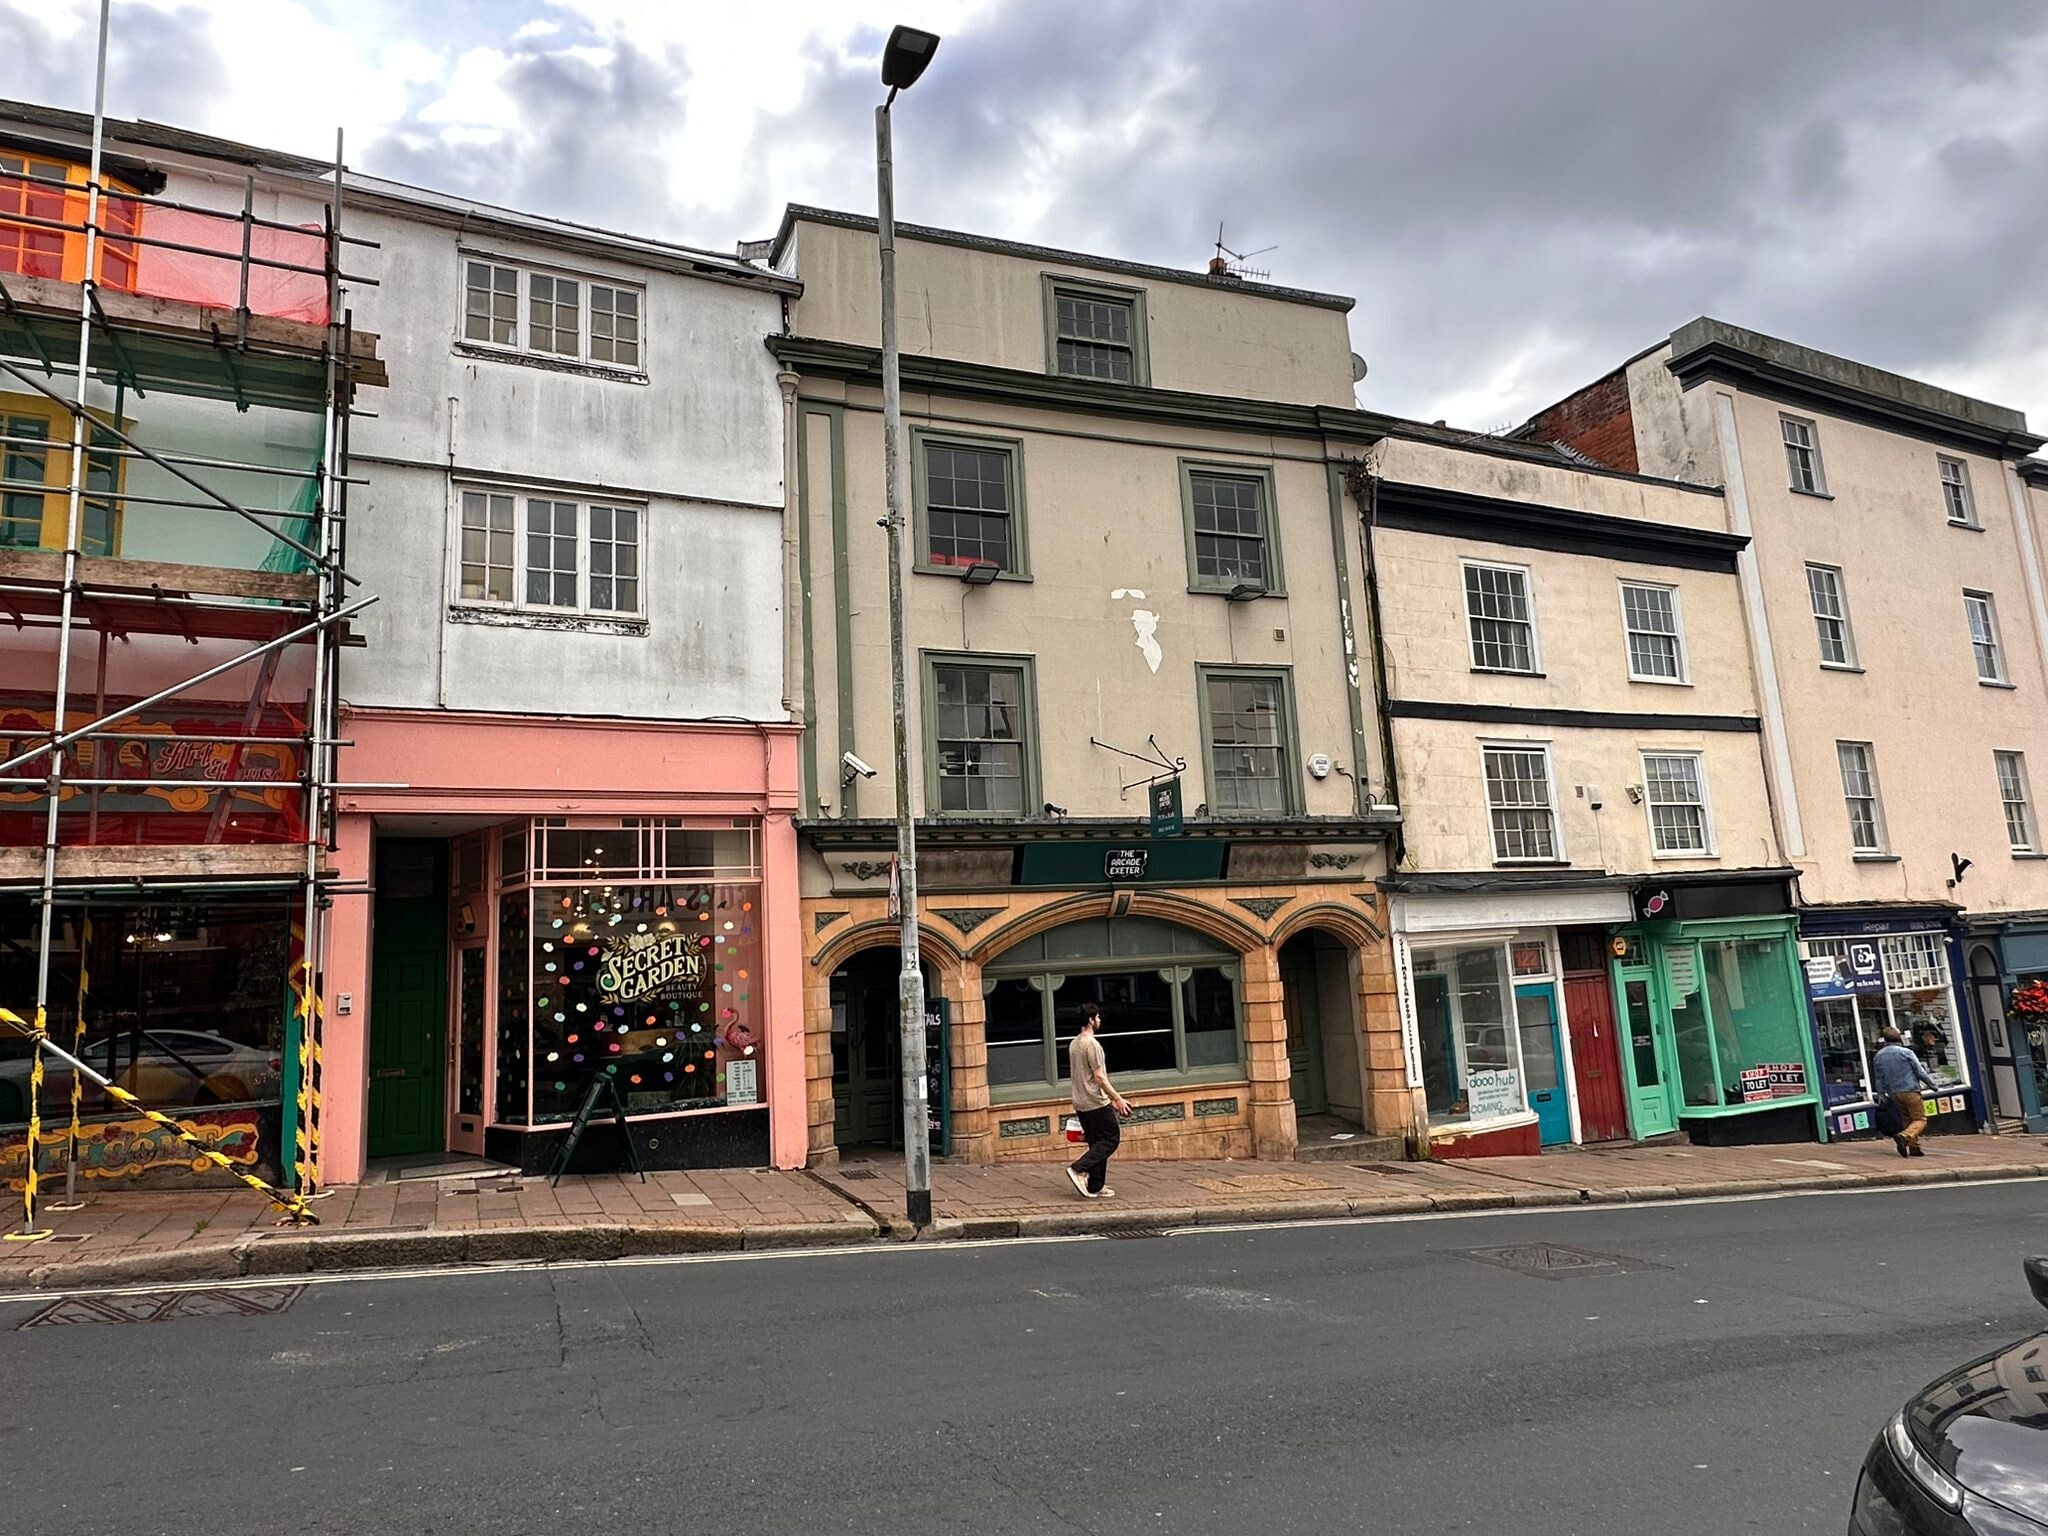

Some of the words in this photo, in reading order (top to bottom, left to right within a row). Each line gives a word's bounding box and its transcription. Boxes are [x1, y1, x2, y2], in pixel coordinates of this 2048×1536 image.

[1120, 850, 1135, 858] THE
[1111, 858, 1142, 866] ARCADE
[1109, 866, 1140, 875] EXETER
[600, 936, 686, 992] SECRET
[620, 955, 700, 999] GARDEN
[660, 991, 703, 1000] BOUTIQUE
[1495, 1071, 1515, 1087] hub
[1780, 1074, 1799, 1083] LET
[1745, 1081, 1755, 1090] TO
[1755, 1080, 1767, 1089] LET
[1471, 1101, 1503, 1114] COMING
